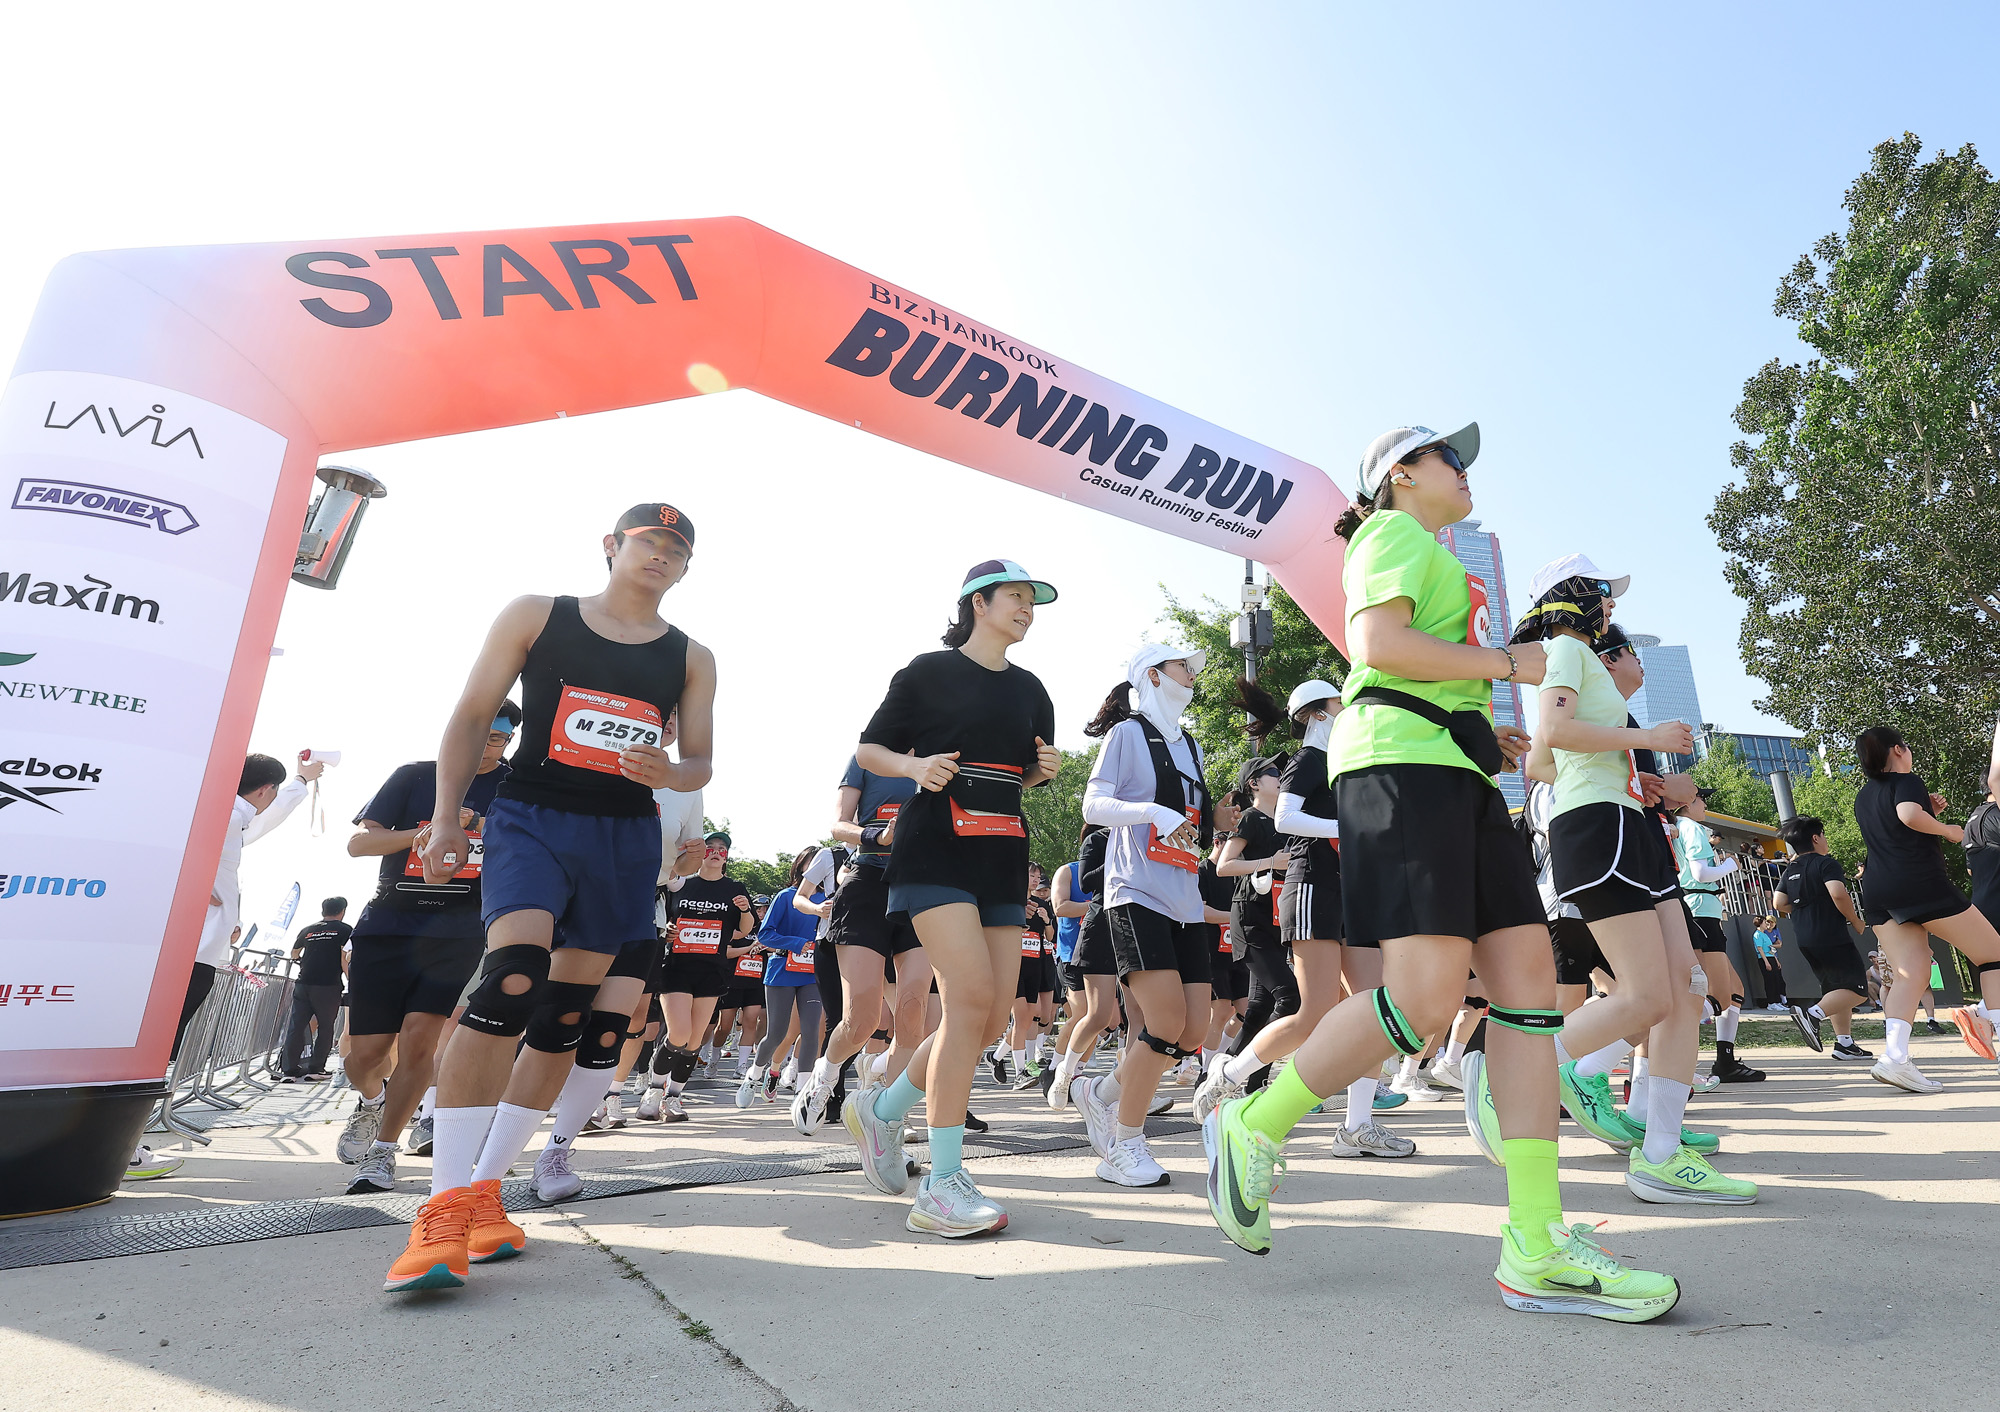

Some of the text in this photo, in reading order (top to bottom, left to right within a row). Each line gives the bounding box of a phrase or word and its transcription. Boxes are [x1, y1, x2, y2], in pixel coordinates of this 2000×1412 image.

[285, 234, 699, 328] START
[824, 307, 1294, 525] BURNING RUN
[24, 486, 173, 530] FAVONEX
[1079, 467, 1263, 540] Casual Running Festival
[0, 680, 147, 714] NEWTREE
[567, 690, 629, 709] BURNING RUN
[575, 718, 595, 731] M
[597, 720, 658, 746] 2579
[0, 757, 102, 782] ebok
[679, 899, 728, 911] Reebok
